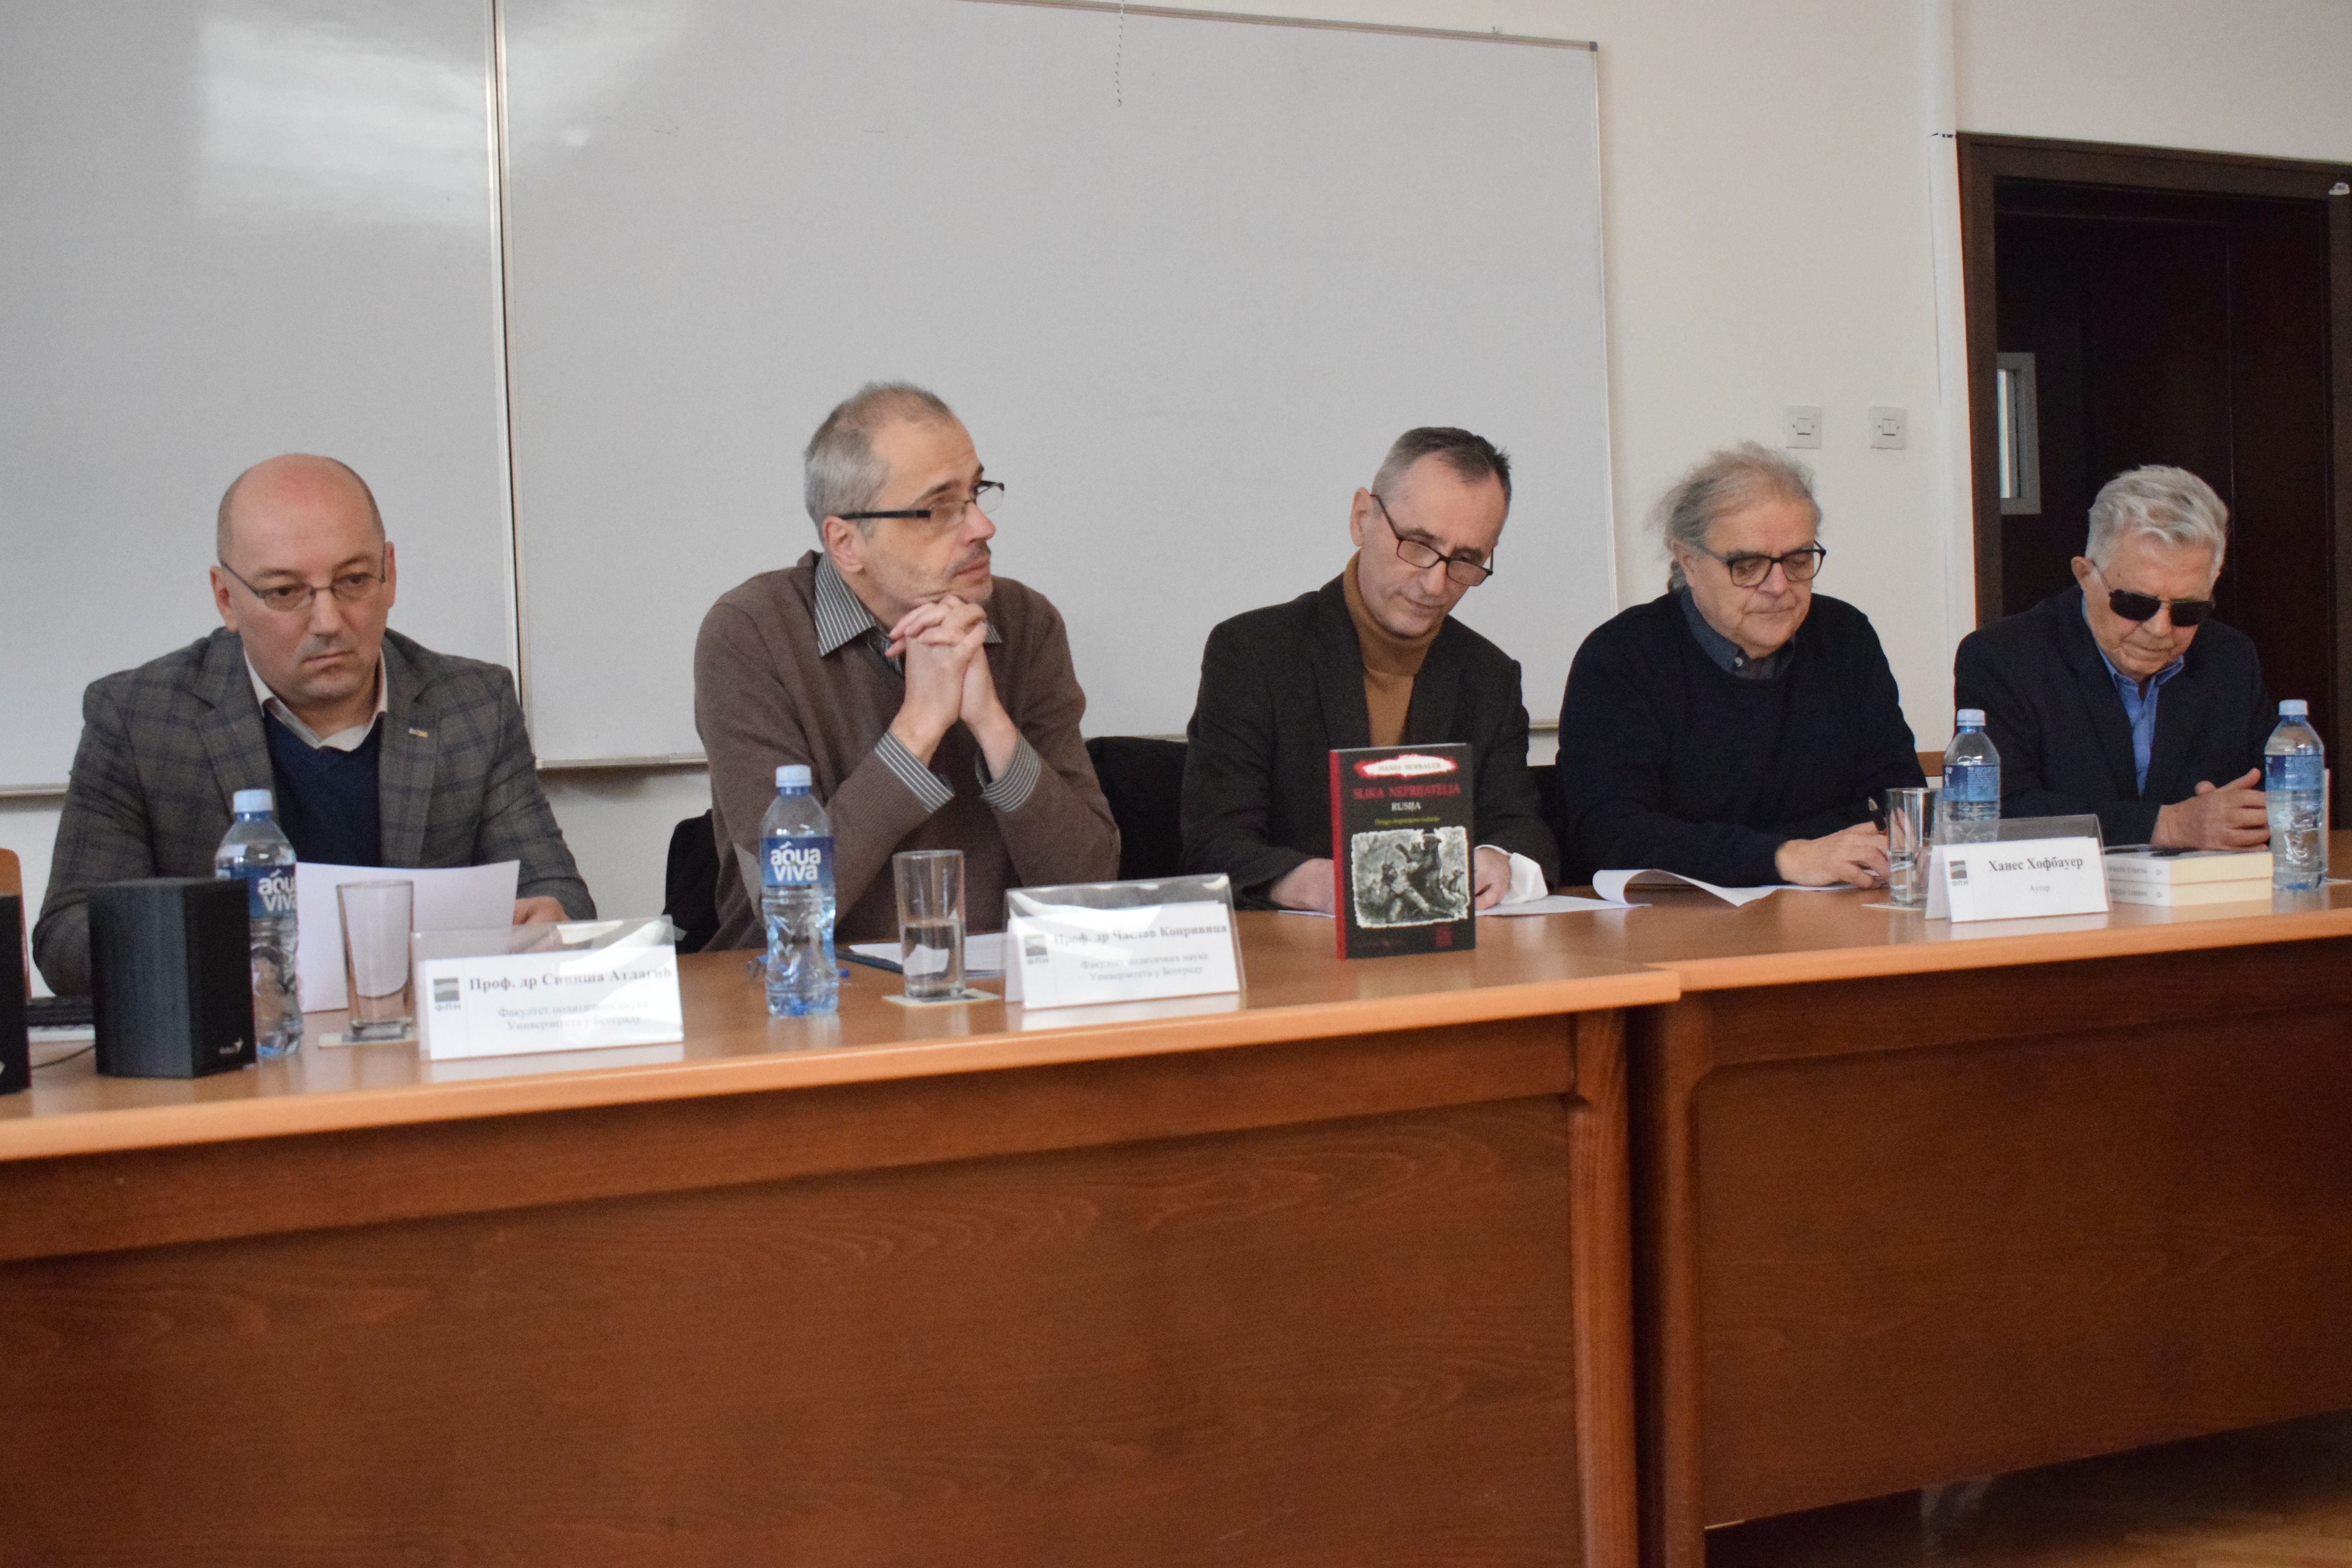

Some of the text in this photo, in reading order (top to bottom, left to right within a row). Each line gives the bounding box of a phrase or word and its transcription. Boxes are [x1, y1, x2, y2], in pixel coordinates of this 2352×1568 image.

[770, 841, 821, 866] aqua
[773, 865, 818, 882] viva
[1988, 857, 2083, 872] Ханес Хофбауер
[1095, 933, 1109, 944] др
[1160, 925, 1227, 938] Копривица
[470, 976, 516, 993] Проф.
[520, 977, 537, 990] др
[542, 972, 604, 985] Синиша
